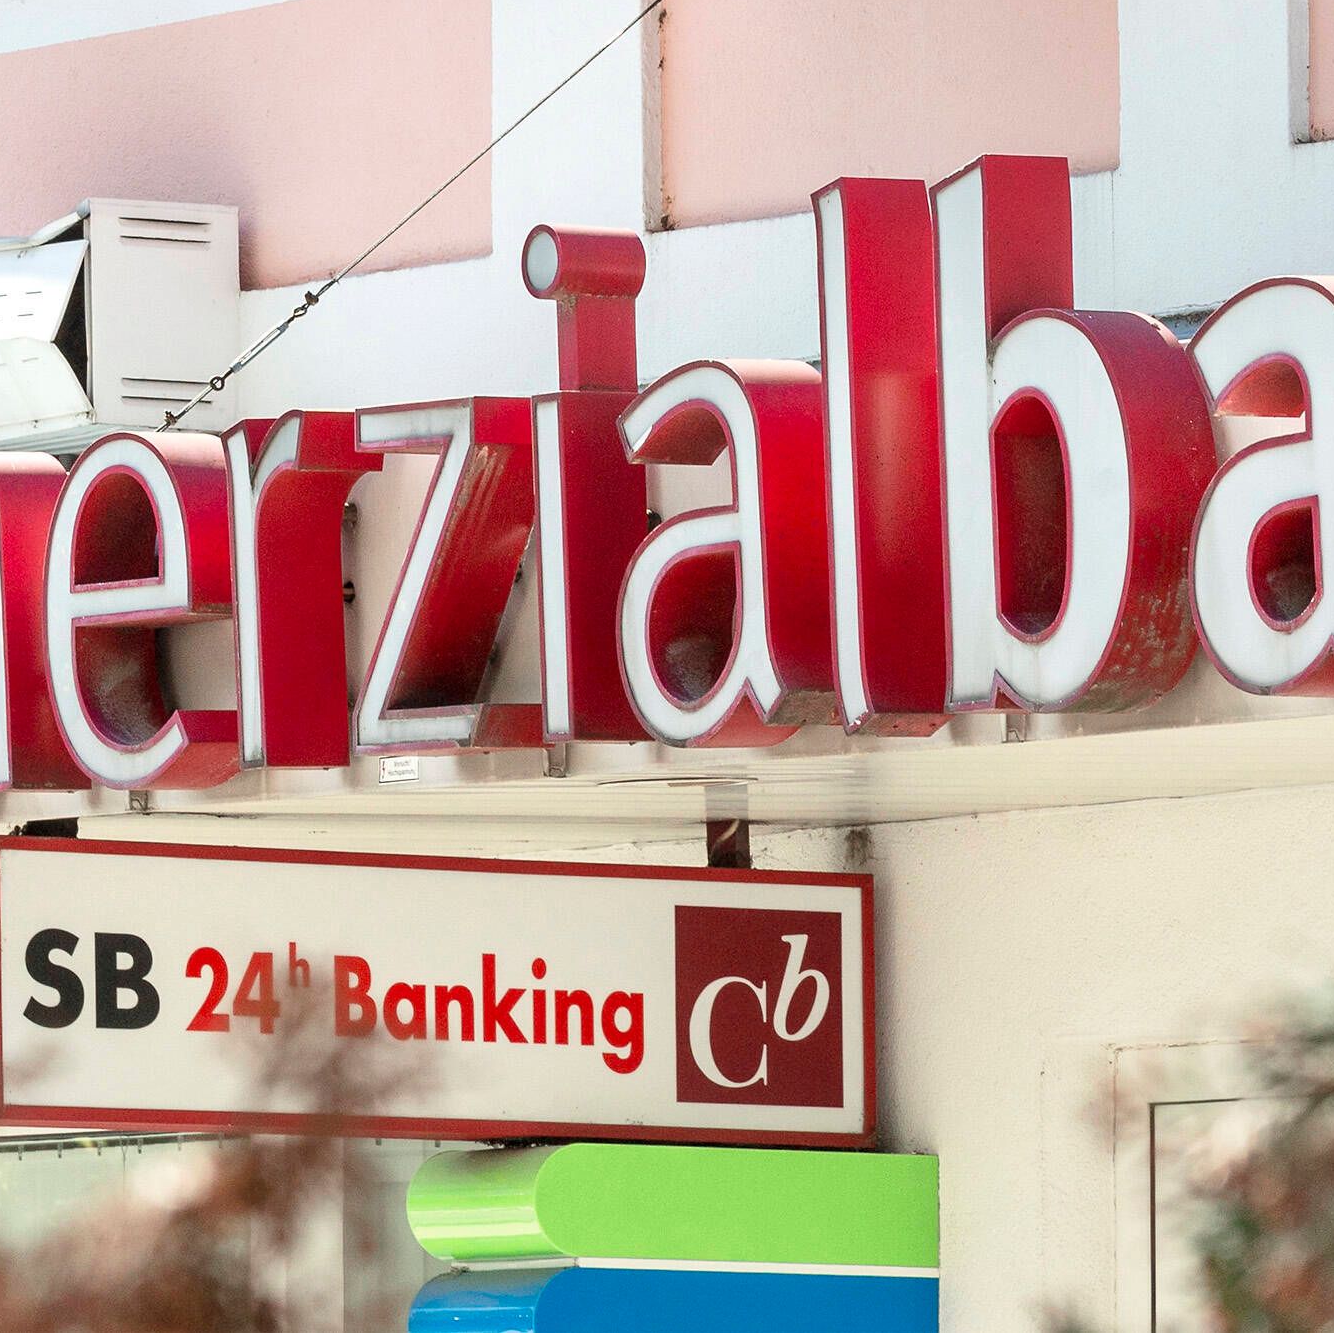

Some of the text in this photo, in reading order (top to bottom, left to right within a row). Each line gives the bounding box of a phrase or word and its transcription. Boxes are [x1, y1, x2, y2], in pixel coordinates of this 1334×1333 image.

[23, 927, 161, 1030] SB
[333, 953, 646, 1075] Banking
[688, 933, 831, 1089] Cb
